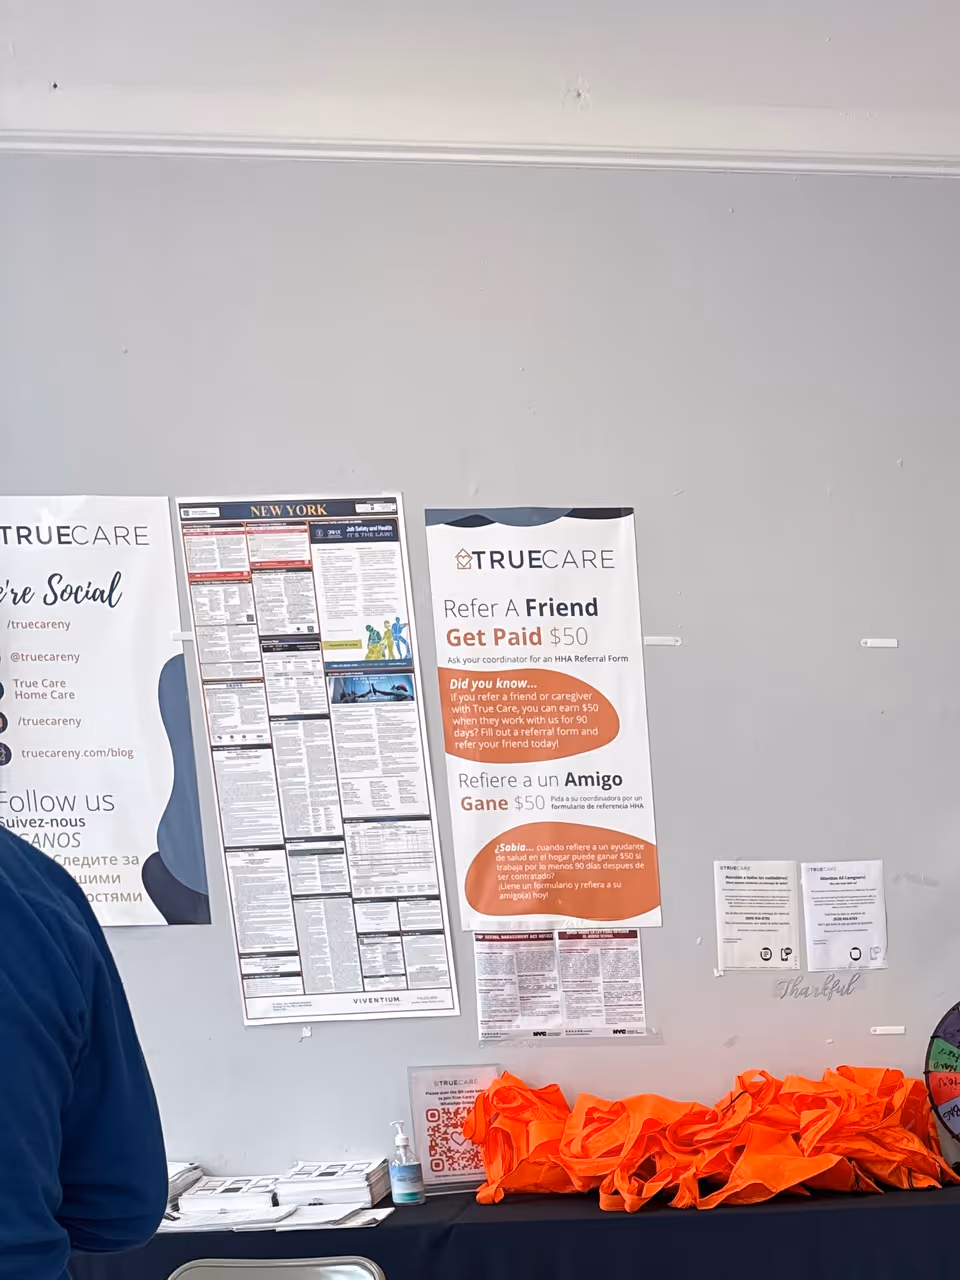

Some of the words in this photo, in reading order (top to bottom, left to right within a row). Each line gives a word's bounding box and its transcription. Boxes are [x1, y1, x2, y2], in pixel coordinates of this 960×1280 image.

[250, 505, 282, 518] NEW
[286, 503, 328, 517] YORK
[472, 550, 615, 569] TRUECARE
[43, 571, 123, 608] Social
[444, 598, 499, 618] Refer
[505, 599, 520, 618] A
[525, 597, 599, 617] Friend
[7, 620, 71, 632] /truecareny
[446, 628, 487, 647] Get
[493, 627, 543, 646] Paid
[550, 626, 588, 646] $50
[10, 652, 80, 664] @truecareny
[447, 656, 461, 664] Ask
[462, 656, 481, 665] your
[482, 656, 527, 664] coordinator
[530, 655, 541, 663] for
[554, 655, 573, 663] HHA
[574, 655, 606, 663] Referral
[608, 655, 629, 663] Form
[13, 678, 38, 688] True
[41, 678, 66, 688] Care
[450, 678, 470, 689] Did
[471, 680, 493, 691] you
[496, 678, 538, 689] know...
[14, 690, 48, 700] Home
[50, 690, 76, 700] Care
[450, 693, 459, 702] If
[459, 694, 475, 703] you
[477, 692, 500, 701] refer
[510, 692, 537, 701] friend
[539, 693, 549, 701] or
[551, 692, 593, 703] caregiver
[451, 704, 471, 713] with
[473, 704, 494, 713] True
[496, 703, 520, 714] Care,
[522, 705, 539, 715] you
[582, 703, 599, 713] $50
[18, 716, 82, 728] /truecareny
[452, 716, 477, 725] when
[479, 716, 500, 726] they
[501, 715, 525, 724] work
[526, 715, 546, 724] with
[548, 716, 559, 724] us
[561, 715, 574, 724] for
[576, 715, 588, 724] 90
[454, 727, 479, 739] days?
[481, 727, 494, 736] Fill
[495, 728, 512, 736] out
[521, 727, 555, 736] referral
[557, 727, 579, 736] form
[581, 726, 598, 735] and
[455, 739, 476, 749] refer
[478, 740, 500, 750] your
[502, 738, 529, 748] friend
[531, 738, 559, 749] today!
[21, 747, 135, 760] truecareny.com/blog
[458, 772, 517, 788] Refiere
[523, 776, 532, 788] a
[538, 776, 559, 788] un
[564, 771, 623, 791] Amigo
[85, 794, 115, 812] us
[460, 796, 509, 811] Gane
[514, 794, 545, 811] $50
[610, 843, 644, 852] ayudante
[122, 855, 139, 866] за
[777, 972, 860, 1001] Thankful
[353, 997, 400, 1005] VIVENTIUM
